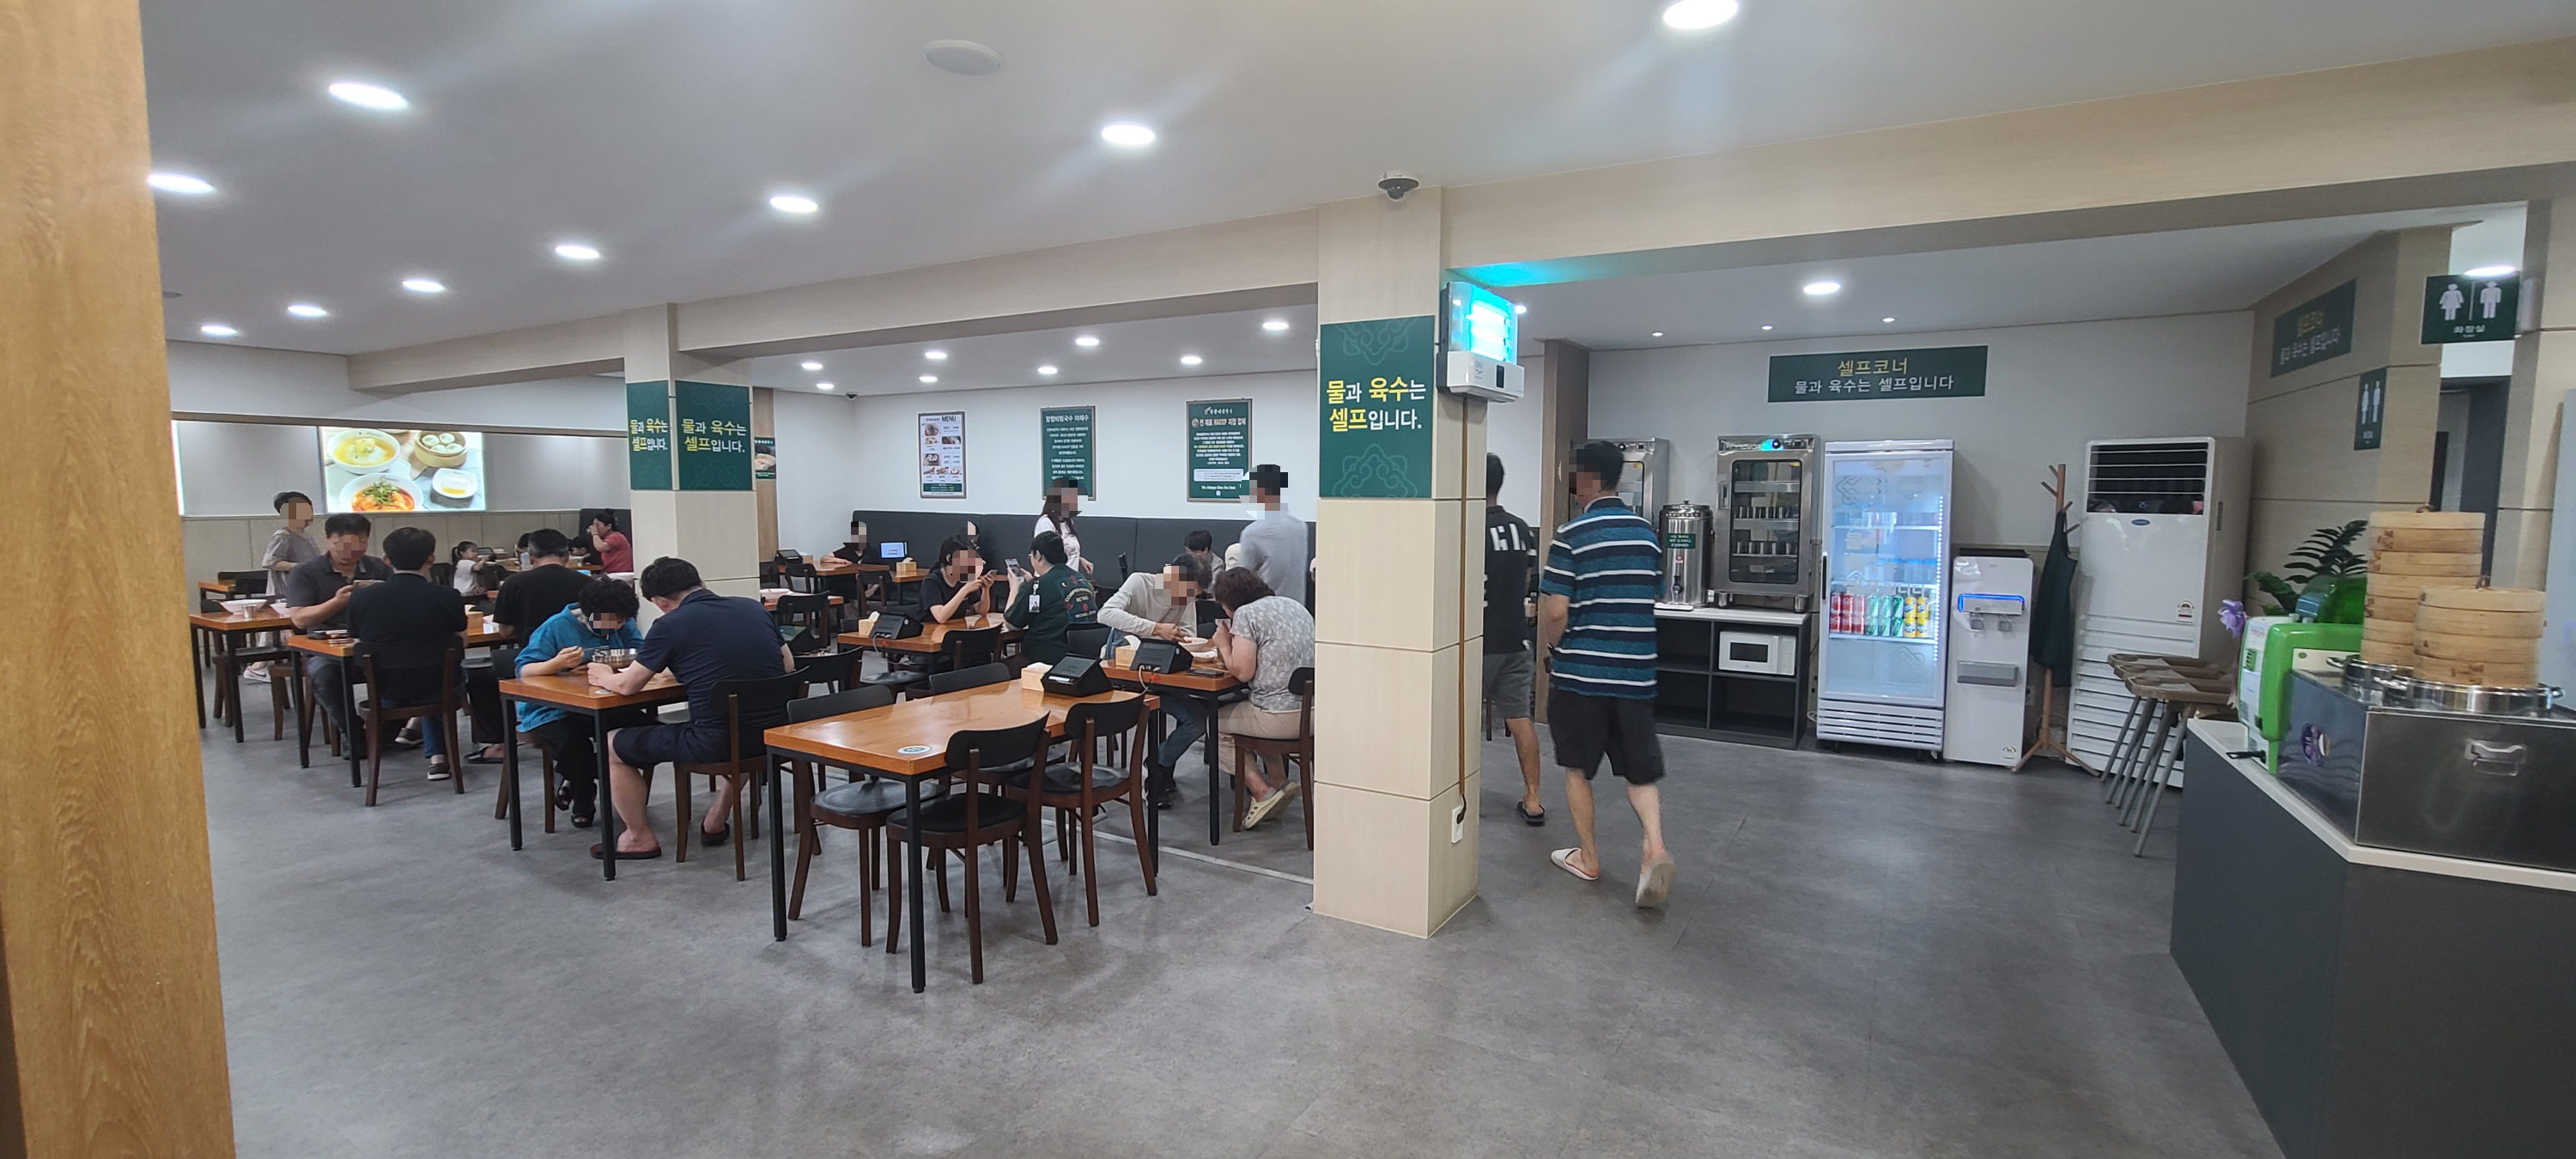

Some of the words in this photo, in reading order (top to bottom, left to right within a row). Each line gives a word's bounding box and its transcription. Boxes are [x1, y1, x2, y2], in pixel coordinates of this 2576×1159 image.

[2453, 325, 2486, 334] 화장실
[1838, 357, 1908, 378] 셀프코너
[1327, 379, 1363, 404] 물과
[1368, 376, 1426, 402] 육수는
[1795, 380, 1822, 395] 물과
[1828, 378, 1872, 395] 육수는
[1878, 375, 1954, 392] 셀프입니다
[629, 419, 644, 434] 물과
[646, 418, 667, 433] 육수는
[682, 418, 707, 434] 물과
[710, 421, 747, 437] 육수는
[1329, 407, 1422, 432] 셀프입니다.
[632, 437, 667, 451] 셀프입니다.
[684, 436, 745, 453] 셀프입니다.
